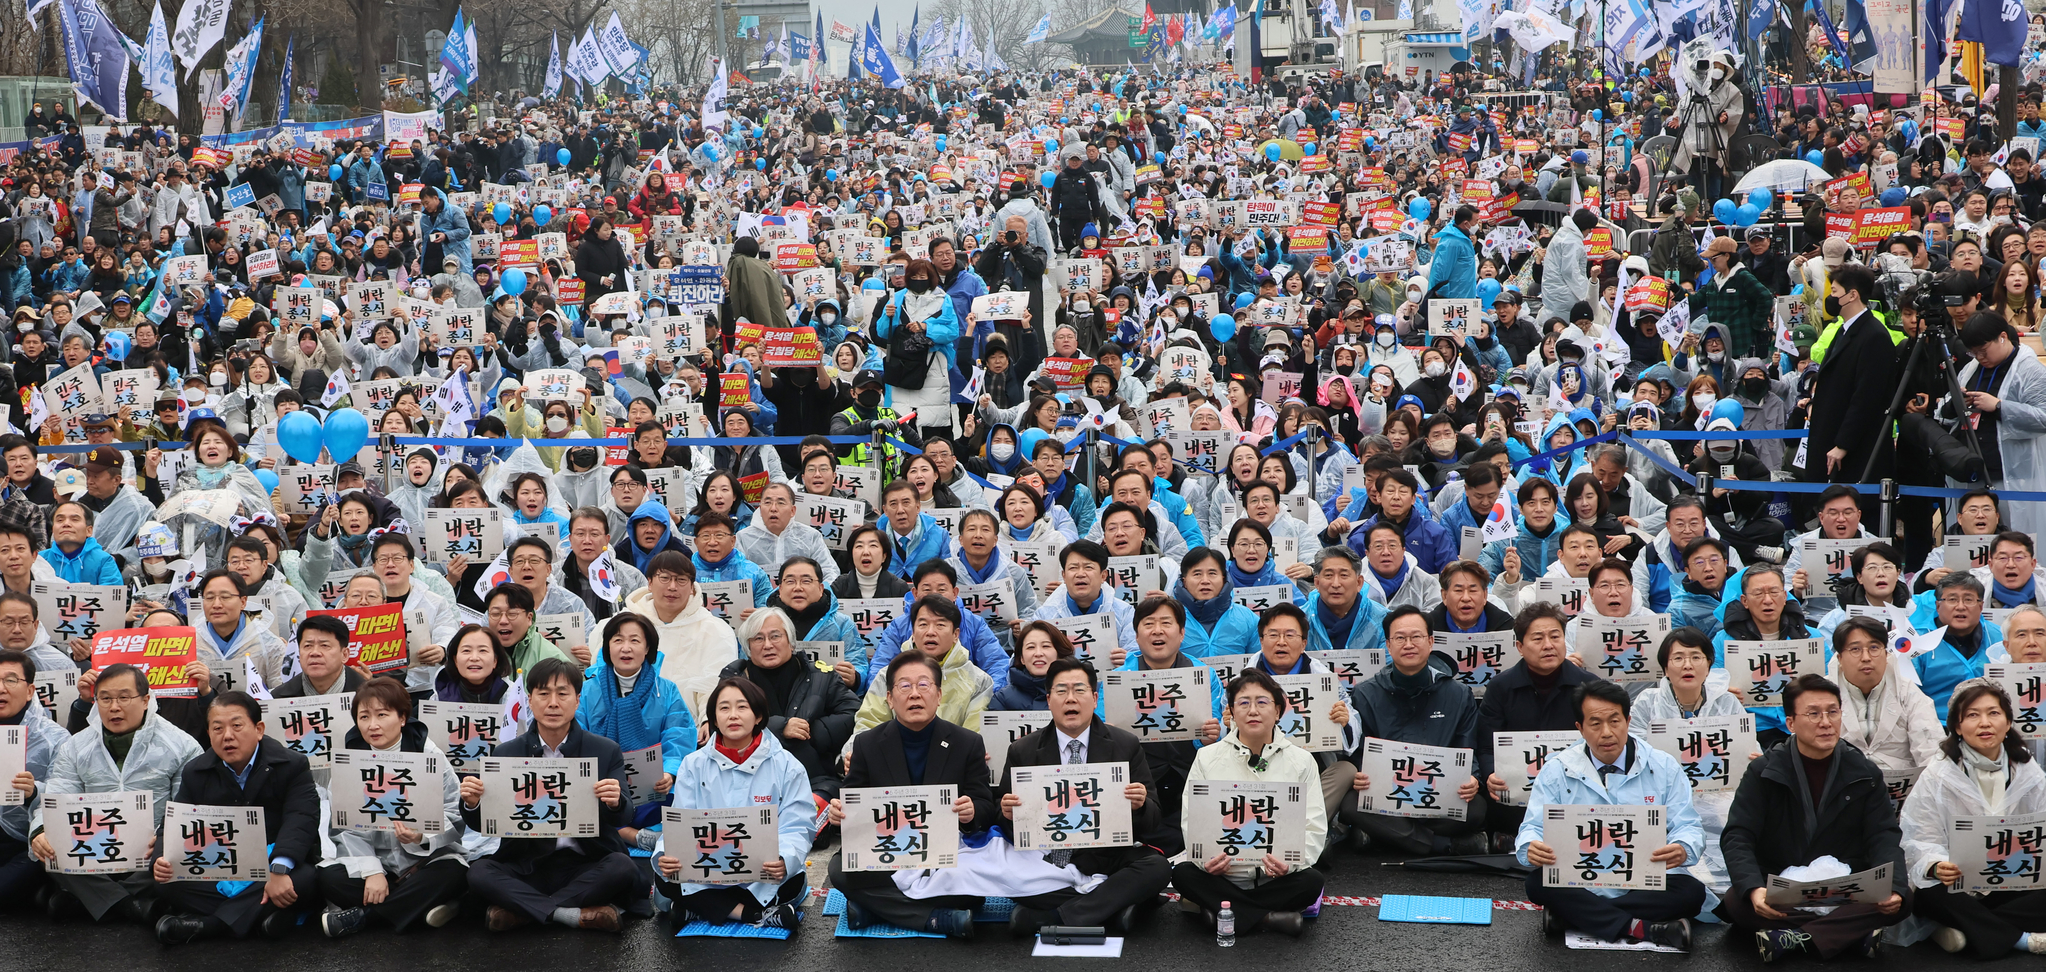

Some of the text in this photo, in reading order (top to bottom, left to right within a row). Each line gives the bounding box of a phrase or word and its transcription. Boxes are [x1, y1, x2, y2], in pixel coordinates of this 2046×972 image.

[1895, 4, 1909, 14] 국군
[610, 26, 629, 52] 민주당
[1828, 175, 1866, 190] 윤석열 파면!
[369, 187, 384, 197] 광진갑
[1185, 203, 1201, 211] 민주
[1218, 206, 1236, 216] 내란
[1246, 202, 1276, 213] 탄핵이
[1304, 202, 1338, 214] 윤석열 파면!
[1488, 201, 1504, 213] 윤석열
[1185, 212, 1202, 221] 수호
[1249, 213, 1280, 224] 민주다!
[1304, 212, 1337, 224] 국힘당 해산!
[1373, 210, 1391, 219] 윤석열
[1827, 216, 1851, 227] 윤석열
[1862, 212, 1904, 225] 윤석열을
[842, 219, 859, 228] 내란
[1218, 217, 1235, 227] 종식
[768, 227, 787, 237] 내란
[927, 229, 944, 238] 내란
[1293, 228, 1322, 237] 윤석열을
[1592, 233, 1610, 242] 파면!
[477, 239, 495, 247] 민주
[501, 243, 537, 252] 윤석열 파면!
[542, 237, 558, 245] 내란
[855, 242, 874, 251] 민주
[1289, 236, 1326, 248] 파면하라!
[478, 248, 495, 256] 수호
[542, 246, 558, 255] 종식
[778, 246, 815, 256] 윤석열 파면!
[1123, 252, 1140, 260] 민주
[1153, 250, 1172, 260] 내란
[1592, 244, 1612, 254] 해산!
[501, 254, 520, 263] 국힘당
[692, 254, 709, 263] 종식
[779, 257, 816, 267] 국힘당 해산!
[854, 253, 874, 262] 수호
[178, 261, 197, 271] 민주
[1068, 265, 1091, 276] 내란
[1122, 262, 1140, 270] 수호
[177, 272, 198, 281] 수호
[804, 274, 825, 285] 민주
[1067, 277, 1090, 290] 종식
[317, 279, 339, 290] 내란
[559, 281, 577, 290] 윤석열
[804, 286, 825, 297] 수호
[288, 294, 312, 306] 내란
[359, 288, 384, 302] 내란
[559, 291, 579, 299] 국힘당
[668, 285, 724, 303] 퇴진하라
[988, 296, 1015, 305] 민주
[1628, 291, 1649, 302] 국힘당
[287, 308, 310, 320] 종식
[360, 302, 384, 317] 종식
[411, 306, 432, 319] 민주
[985, 306, 1014, 317] 수호
[1262, 307, 1287, 321] 종식
[1442, 306, 1469, 319] 내란
[447, 315, 473, 328] 내란
[446, 329, 472, 343] 종식
[663, 322, 692, 337] 내란
[740, 327, 762, 339] 파면!
[764, 331, 816, 344] 윤석열 파면!
[664, 337, 690, 353] 종식
[765, 346, 818, 359] 국힘당 해산!
[1171, 353, 1198, 368] 내란
[541, 374, 572, 385] 내란
[1170, 369, 1198, 383] 종식
[55, 377, 83, 398] 민주
[114, 378, 139, 392] 민주
[538, 384, 569, 397] 종식
[723, 378, 747, 390] 파면!
[367, 386, 394, 400] 내란
[724, 394, 748, 405] 해산!
[62, 393, 90, 414] 수호
[114, 393, 139, 408] 수호
[660, 411, 690, 430] 내란
[1148, 408, 1174, 425] 민주
[1185, 439, 1219, 455] 내란
[1183, 456, 1216, 473] 종식
[297, 474, 335, 491] 민주
[810, 505, 847, 526] 내란
[445, 518, 484, 537] 내란
[444, 539, 482, 559] 종식
[56, 595, 104, 618] 민주
[962, 593, 1004, 613] 민주
[356, 613, 400, 636] 파면!
[852, 609, 892, 630] 민주
[54, 620, 100, 641] 수호
[94, 634, 193, 658] 윤석열 파면!
[1602, 629, 1651, 652] 민주
[359, 641, 402, 663] 해산!
[1456, 644, 1505, 668] 내란
[1598, 655, 1650, 676] 수호
[1748, 652, 1801, 677] 내란
[146, 664, 191, 686] 해산!
[1132, 683, 1186, 709] 민주
[1287, 688, 1314, 714] 란
[280, 707, 334, 738] 내란
[446, 716, 500, 741] 내란
[1131, 712, 1187, 736] 수호
[1677, 729, 1733, 758] 내란
[1391, 756, 1445, 784] 민주
[360, 765, 416, 795] 민주
[511, 772, 571, 800] 내란
[753, 795, 772, 803] 진보당
[1043, 778, 1103, 809] 내란
[1386, 785, 1441, 809] 수호
[359, 797, 417, 823] 수호
[510, 802, 567, 831] 종식
[872, 800, 932, 831] 내란
[1219, 795, 1279, 824] 내란
[67, 808, 127, 835] 민주
[1043, 810, 1100, 842] 종식
[181, 819, 239, 847] 내란
[692, 822, 751, 848] 민주
[1576, 819, 1638, 848] 내란
[871, 832, 928, 863] 종식
[1216, 827, 1274, 856] 종식
[1984, 827, 2046, 856] 내란
[67, 839, 127, 867] 수호
[180, 849, 237, 875] 종식
[691, 852, 752, 878] 수호
[1573, 851, 1633, 881] 종식
[1979, 856, 2041, 884] 종식
[1801, 883, 1863, 901] 민주
